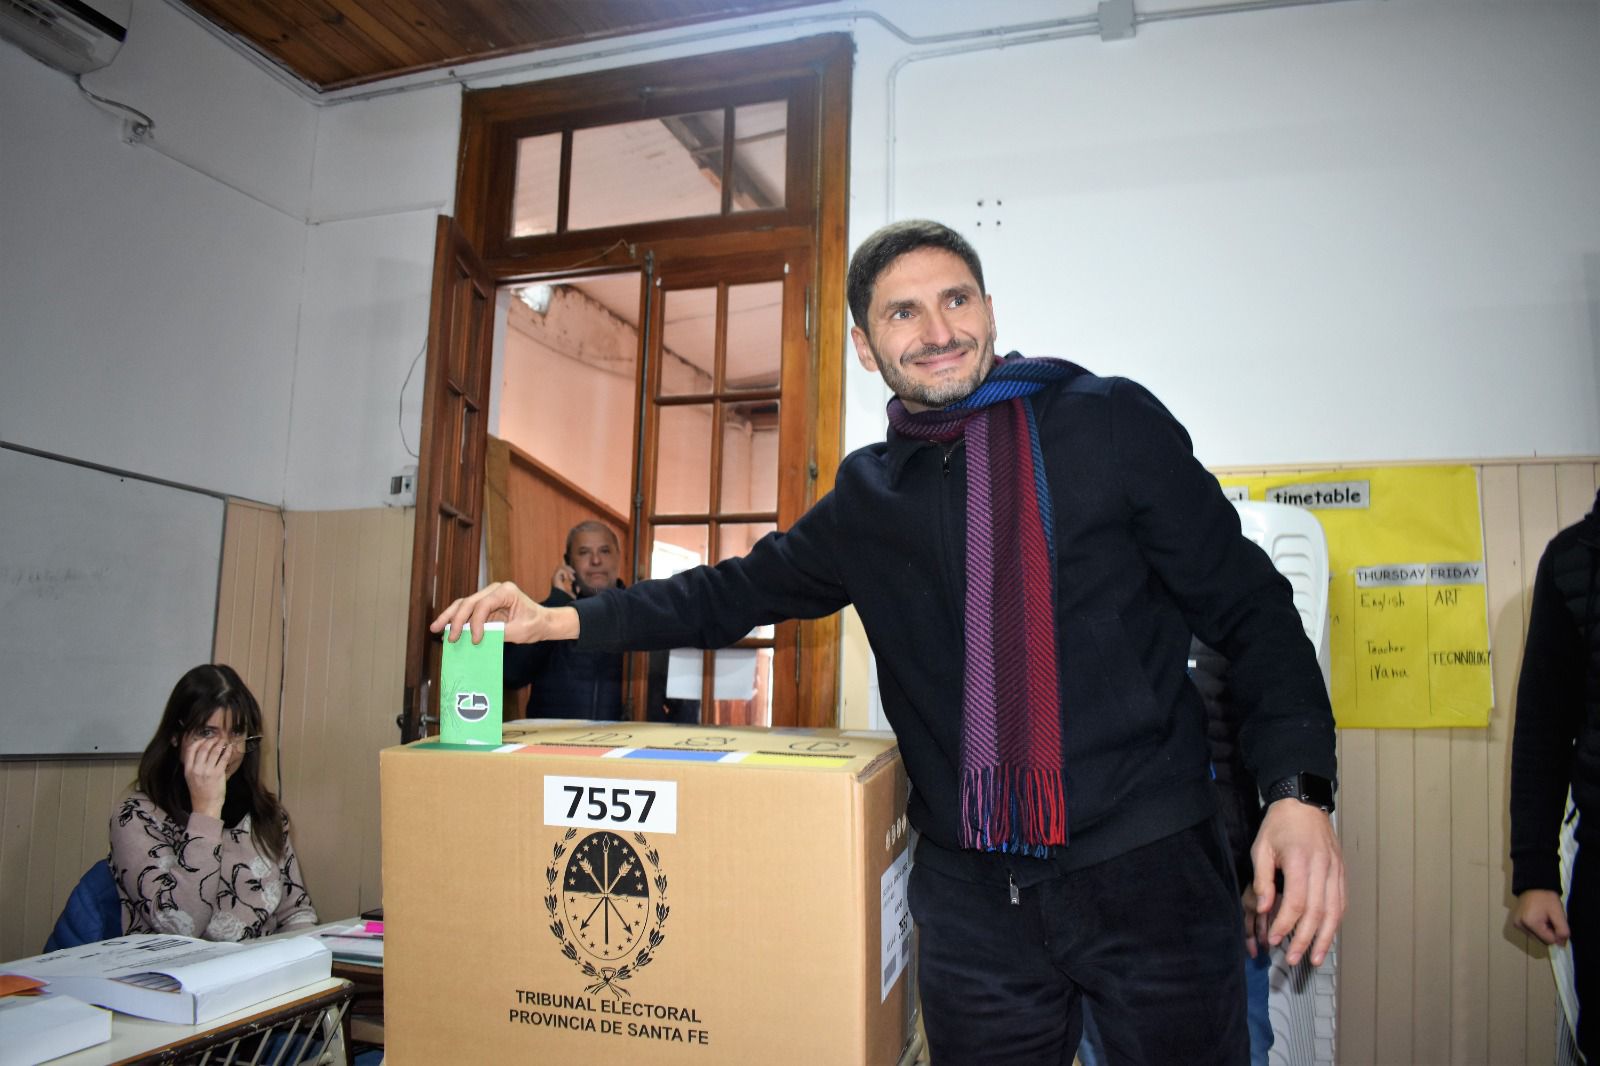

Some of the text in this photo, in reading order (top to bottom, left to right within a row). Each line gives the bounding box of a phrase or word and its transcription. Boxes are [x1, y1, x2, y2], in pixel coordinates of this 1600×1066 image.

[1273, 487, 1361, 505] timetable
[1357, 566, 1480, 582] THURSDAY FRIDAY
[1434, 588, 1462, 606] ART
[1366, 640, 1406, 656] Teacher
[563, 785, 656, 824] 7557
[516, 990, 701, 1023] TRIBUNAL ELECTORAL
[509, 1008, 709, 1046] PROVINCIA DE SANTA FE
